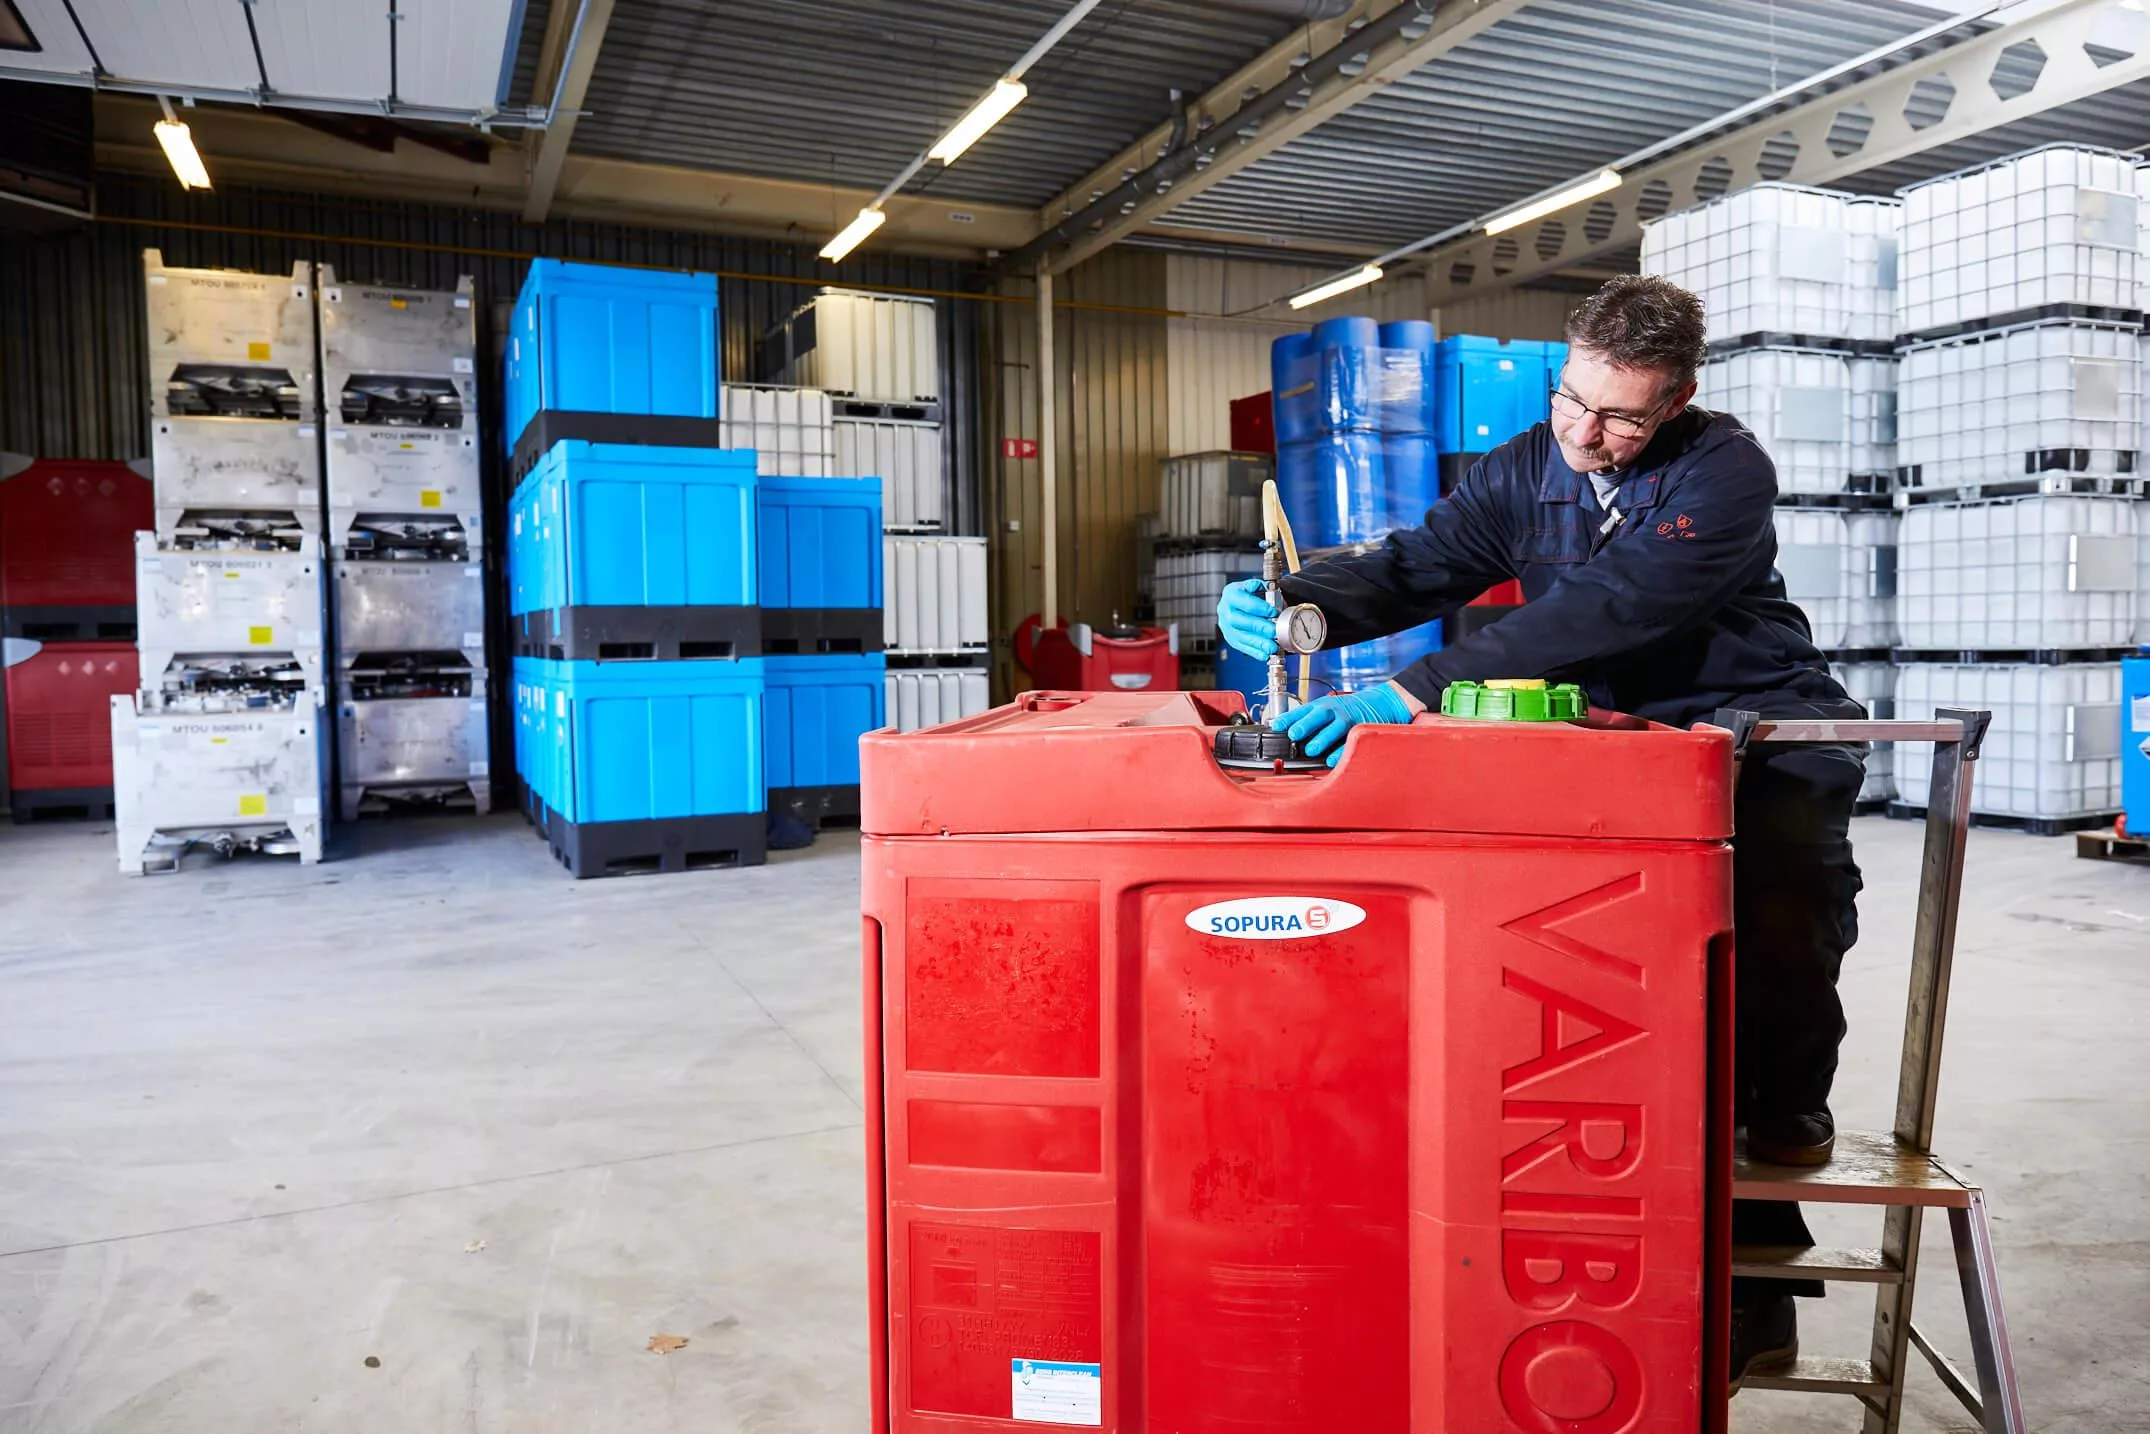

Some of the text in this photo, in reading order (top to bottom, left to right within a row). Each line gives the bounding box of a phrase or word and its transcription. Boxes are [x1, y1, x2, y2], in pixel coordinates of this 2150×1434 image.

[172, 724, 209, 735] MTOU
[1210, 914, 1302, 932] SOPURA
[1497, 870, 1650, 1434] VARIBO
